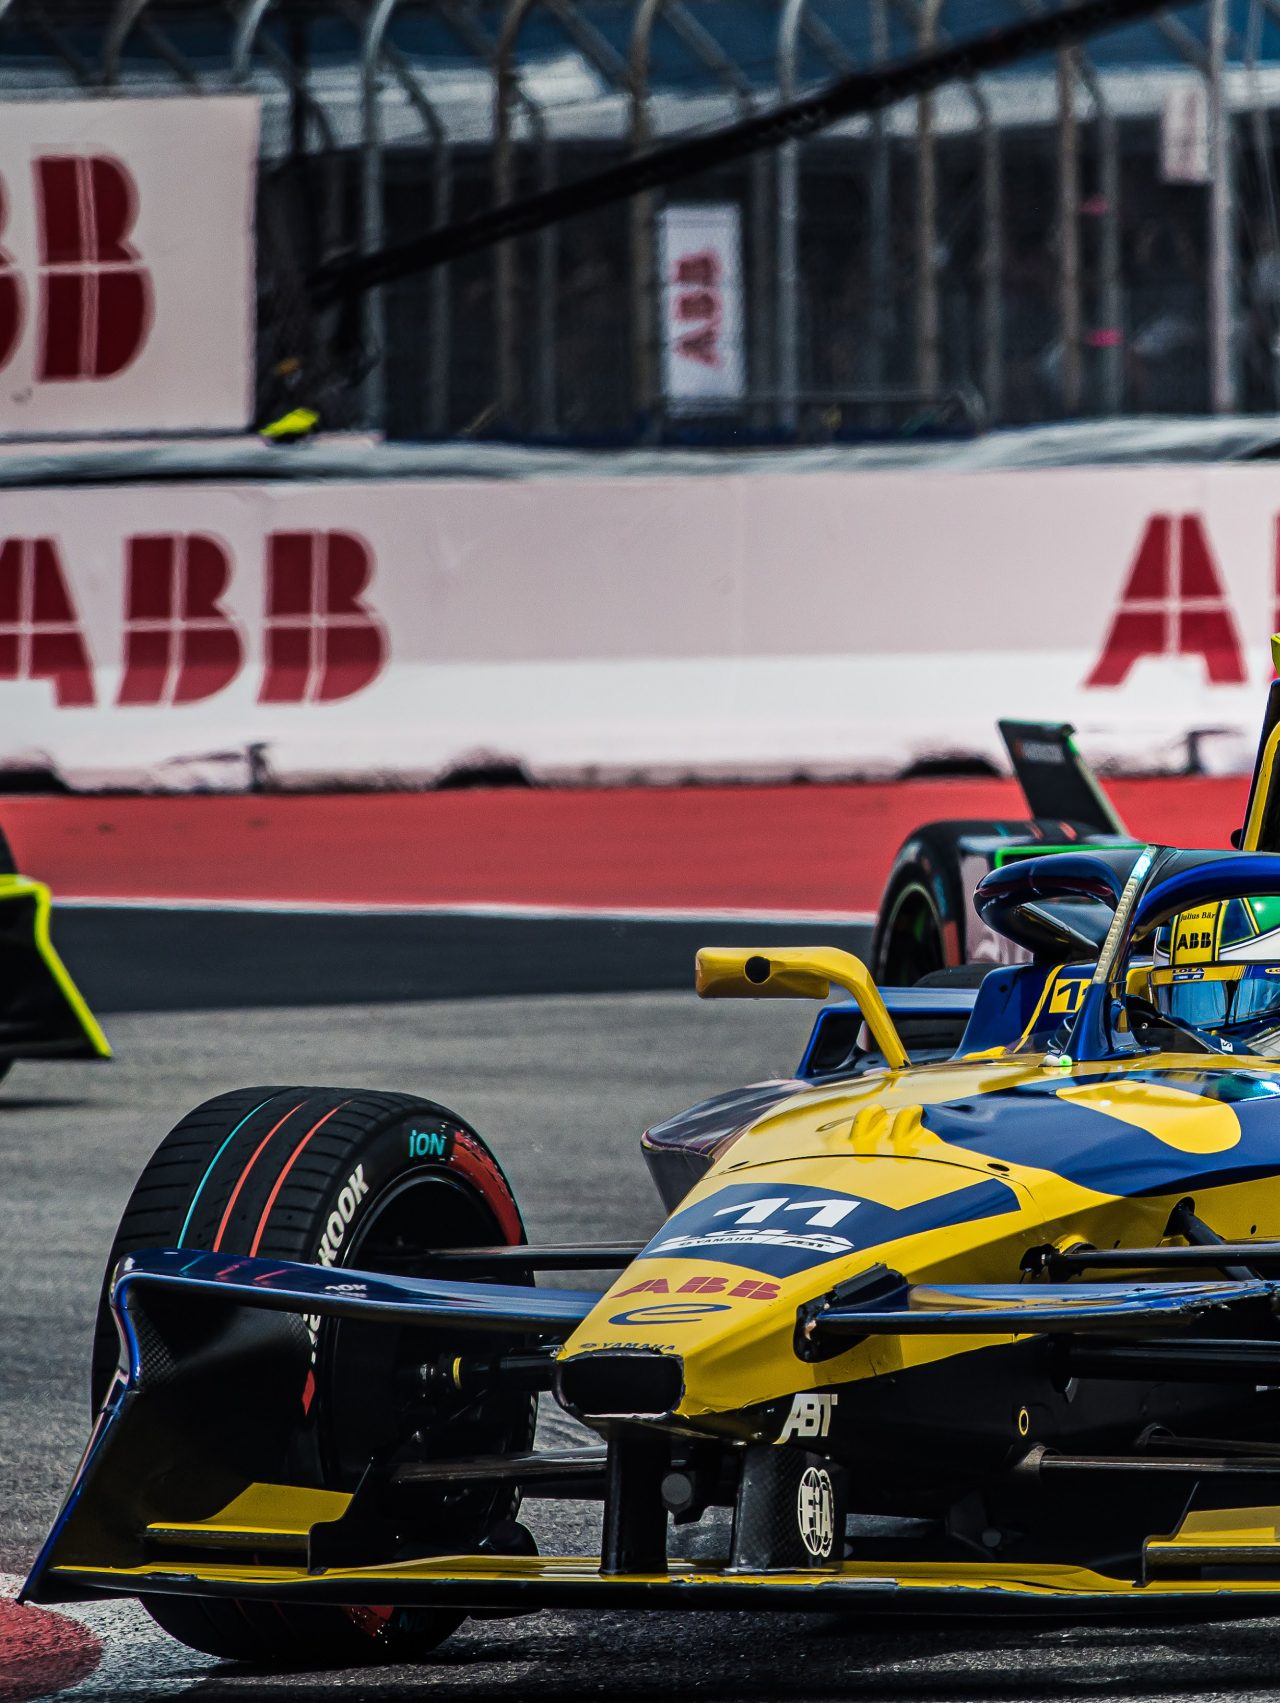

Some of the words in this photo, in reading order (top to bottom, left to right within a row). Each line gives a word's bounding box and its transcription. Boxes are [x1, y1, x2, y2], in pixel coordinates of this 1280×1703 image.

[0, 154, 155, 383] B
[673, 251, 722, 369] ABB
[1176, 932, 1212, 951] ABB
[1057, 980, 1087, 1010] 1
[713, 1197, 862, 1228] 11
[660, 1229, 855, 1248] LOLA
[695, 1236, 754, 1245] YAMAHA
[608, 1276, 782, 1300] ABB
[600, 1342, 676, 1351] YAMAHA
[772, 1393, 838, 1445] ABT
